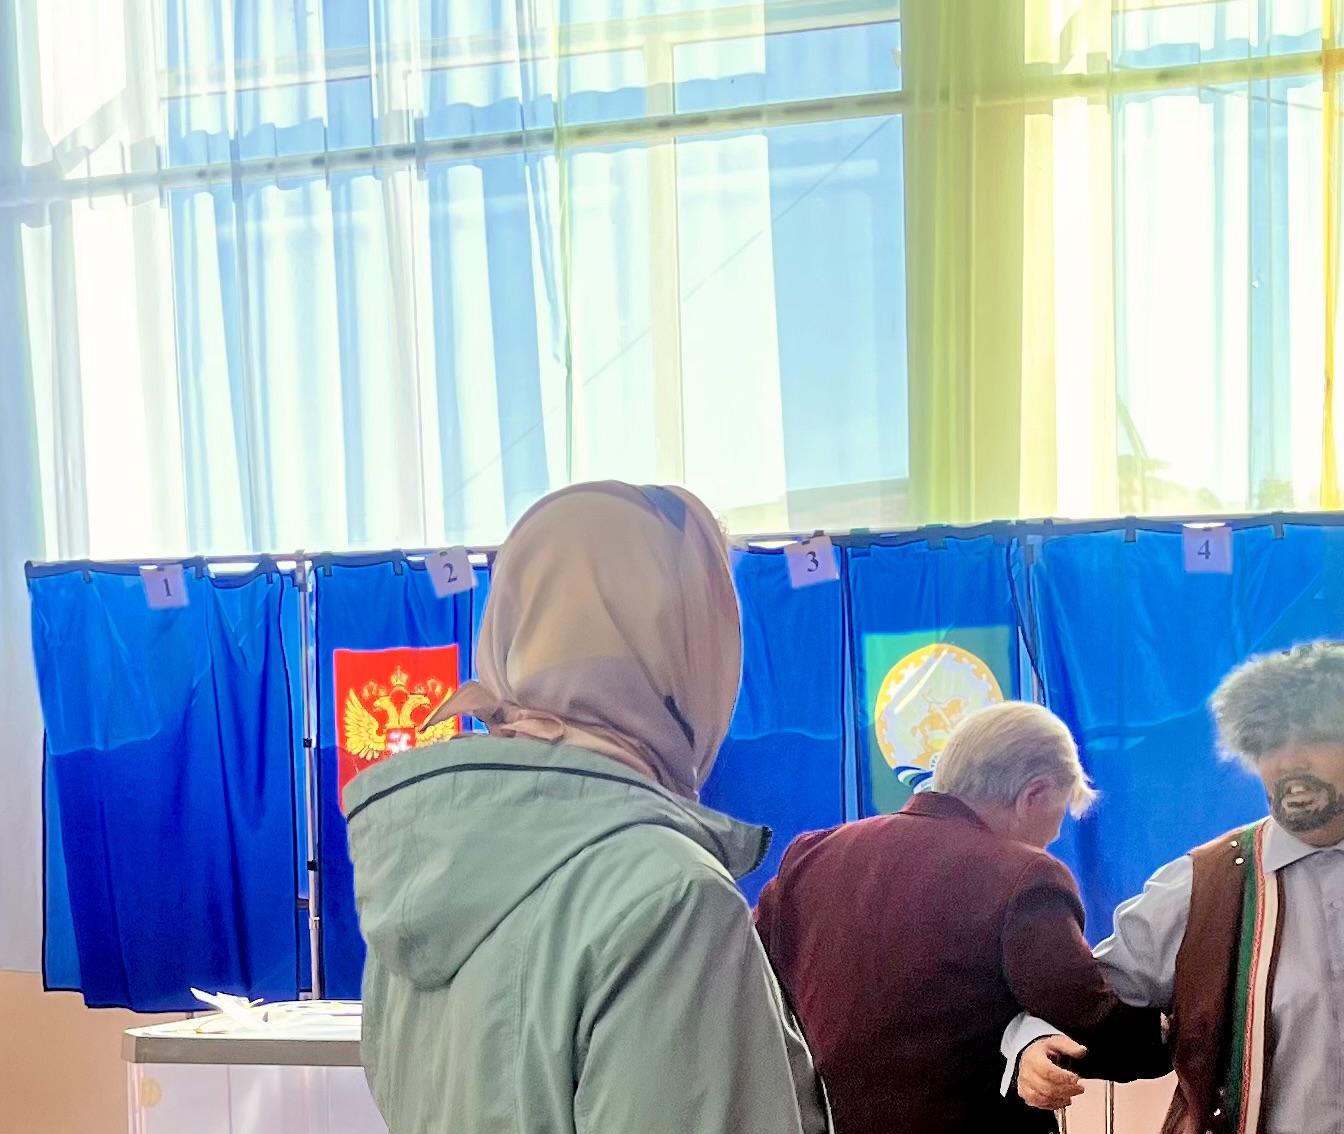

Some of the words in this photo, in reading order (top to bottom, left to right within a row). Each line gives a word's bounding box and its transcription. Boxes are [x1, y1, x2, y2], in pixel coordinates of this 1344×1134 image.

[1197, 540, 1211, 560] 4
[806, 551, 819, 573] 3
[443, 562, 458, 583] 2
[162, 578, 173, 597] 1
